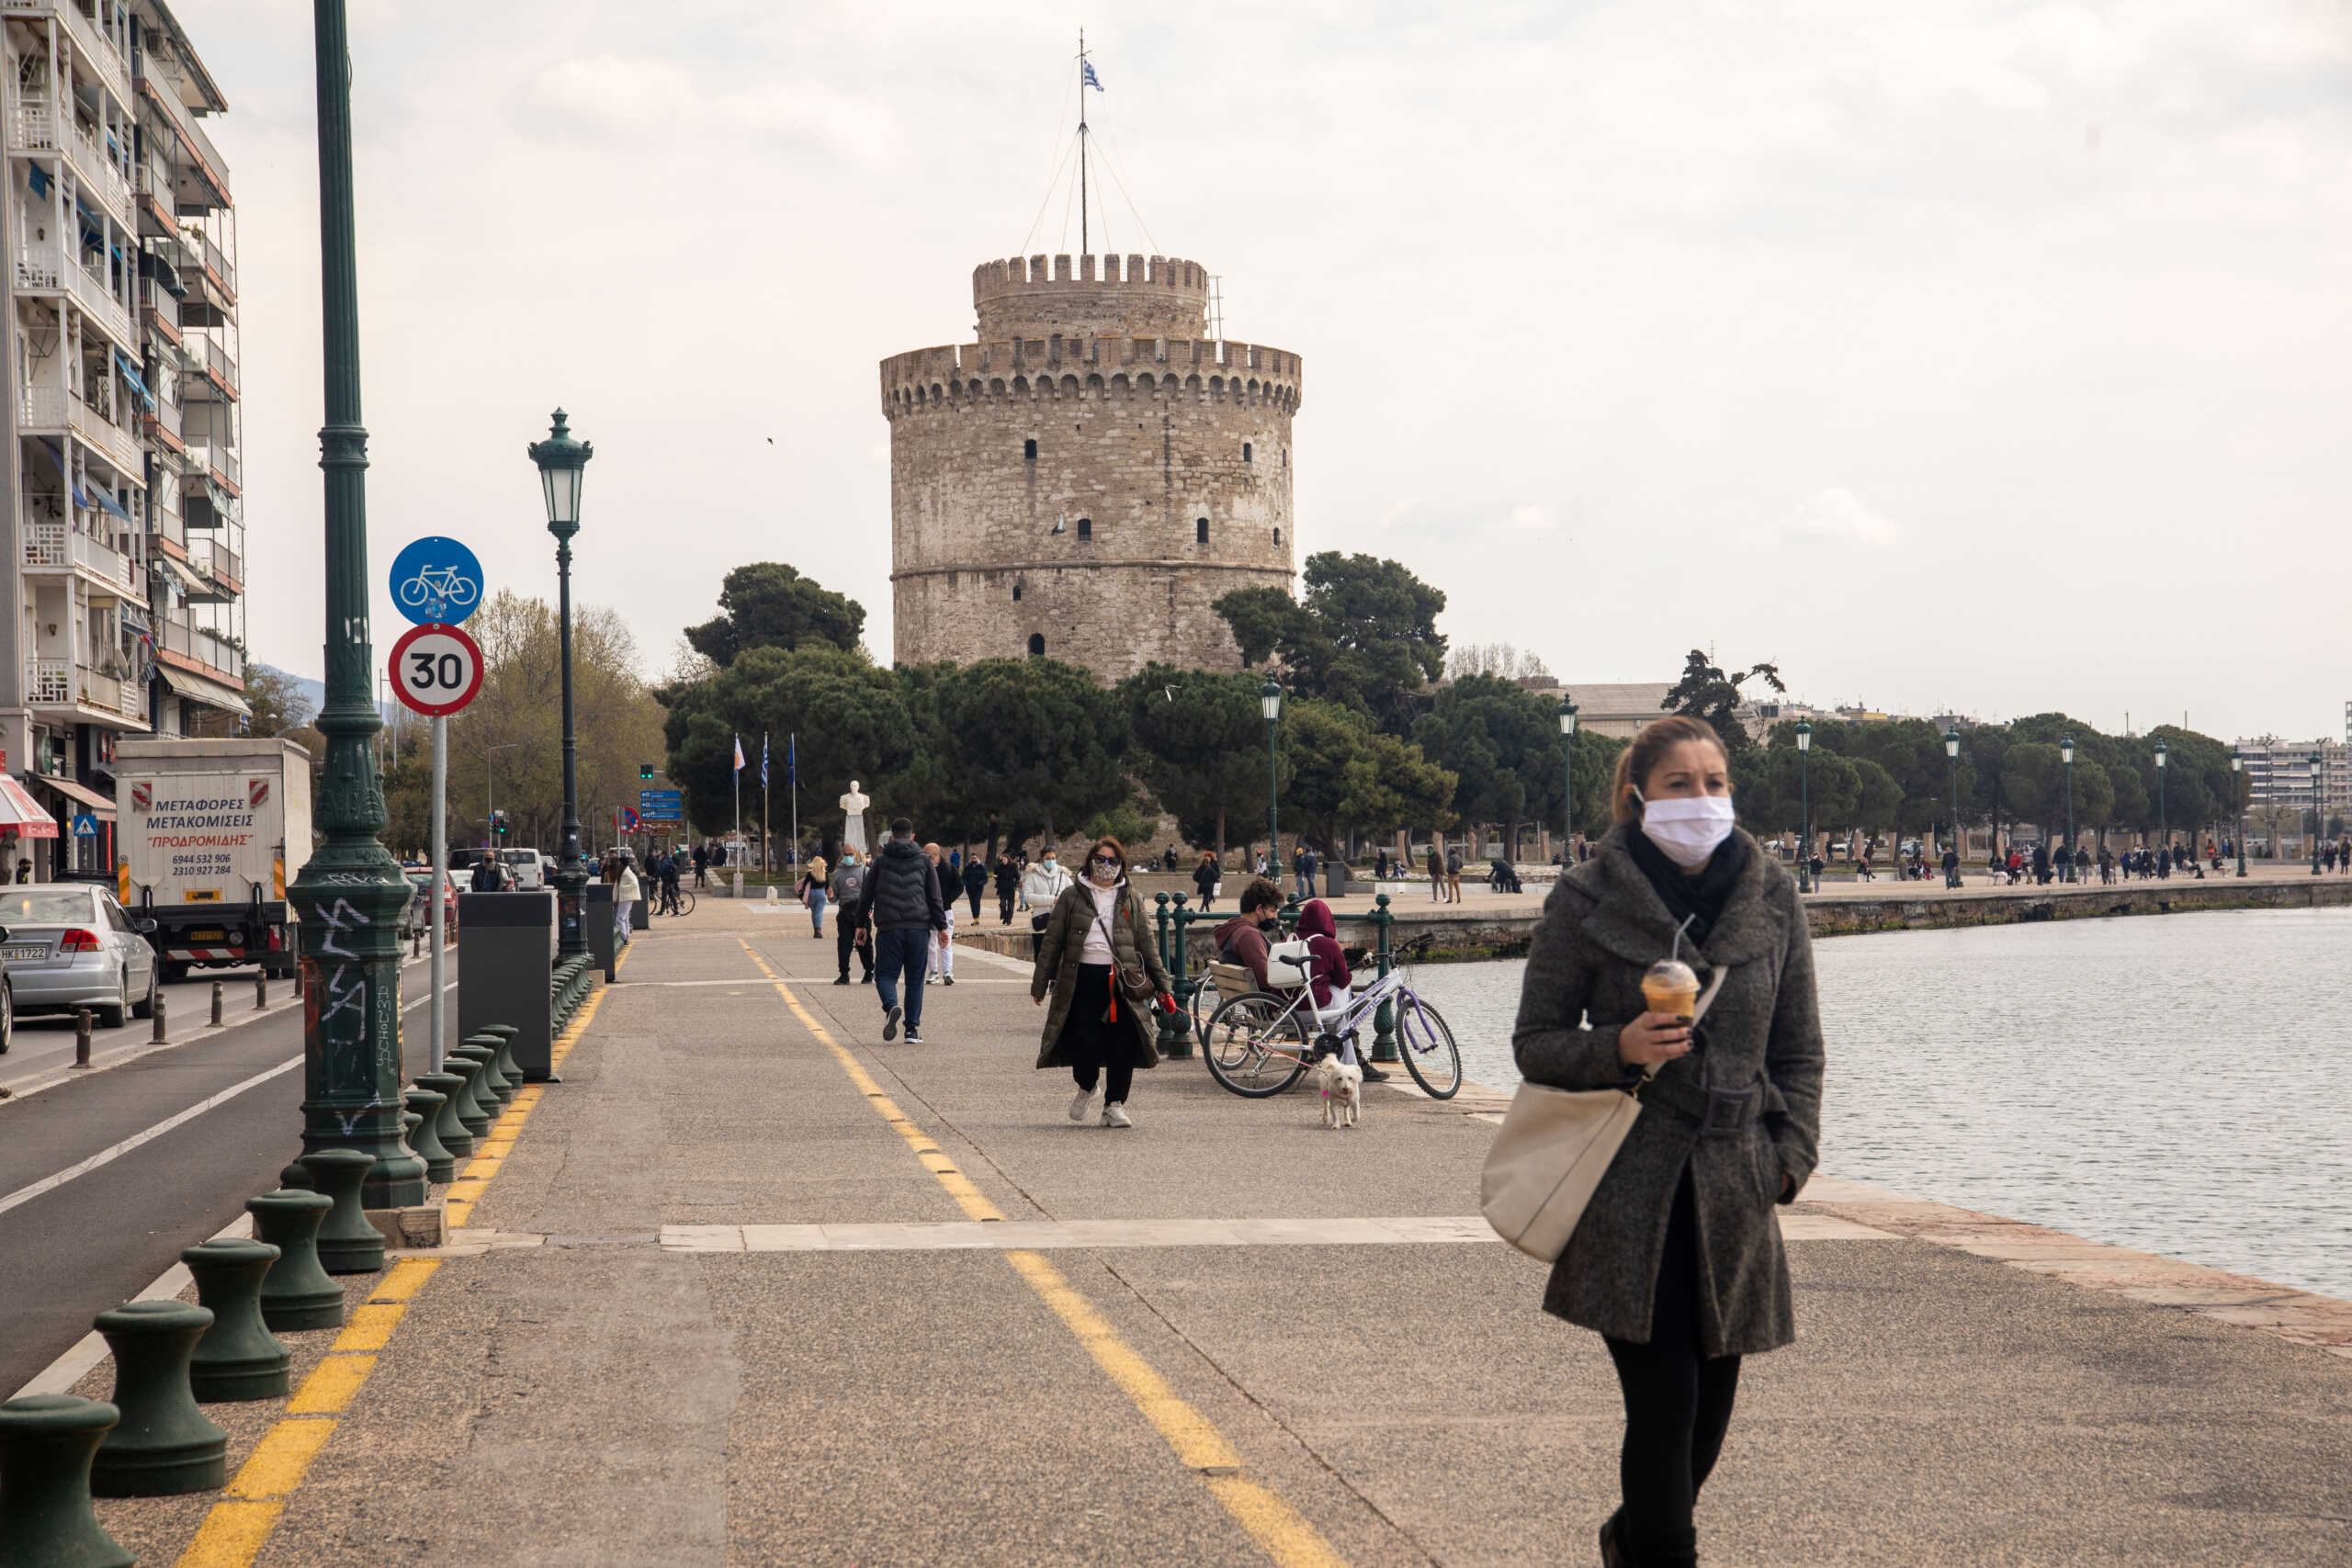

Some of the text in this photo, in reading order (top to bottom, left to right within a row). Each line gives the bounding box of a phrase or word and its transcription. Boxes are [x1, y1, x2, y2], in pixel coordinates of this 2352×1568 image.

[410, 652, 462, 689] 30
[155, 799, 244, 811] ΜΕΤΑΦΟΡΕΣ
[147, 815, 254, 829] ΜΕΤΑΚΟΜΙΣΕΙΣ
[172, 854, 231, 864] 6944 532 906
[172, 865, 231, 876] 2310 927 284
